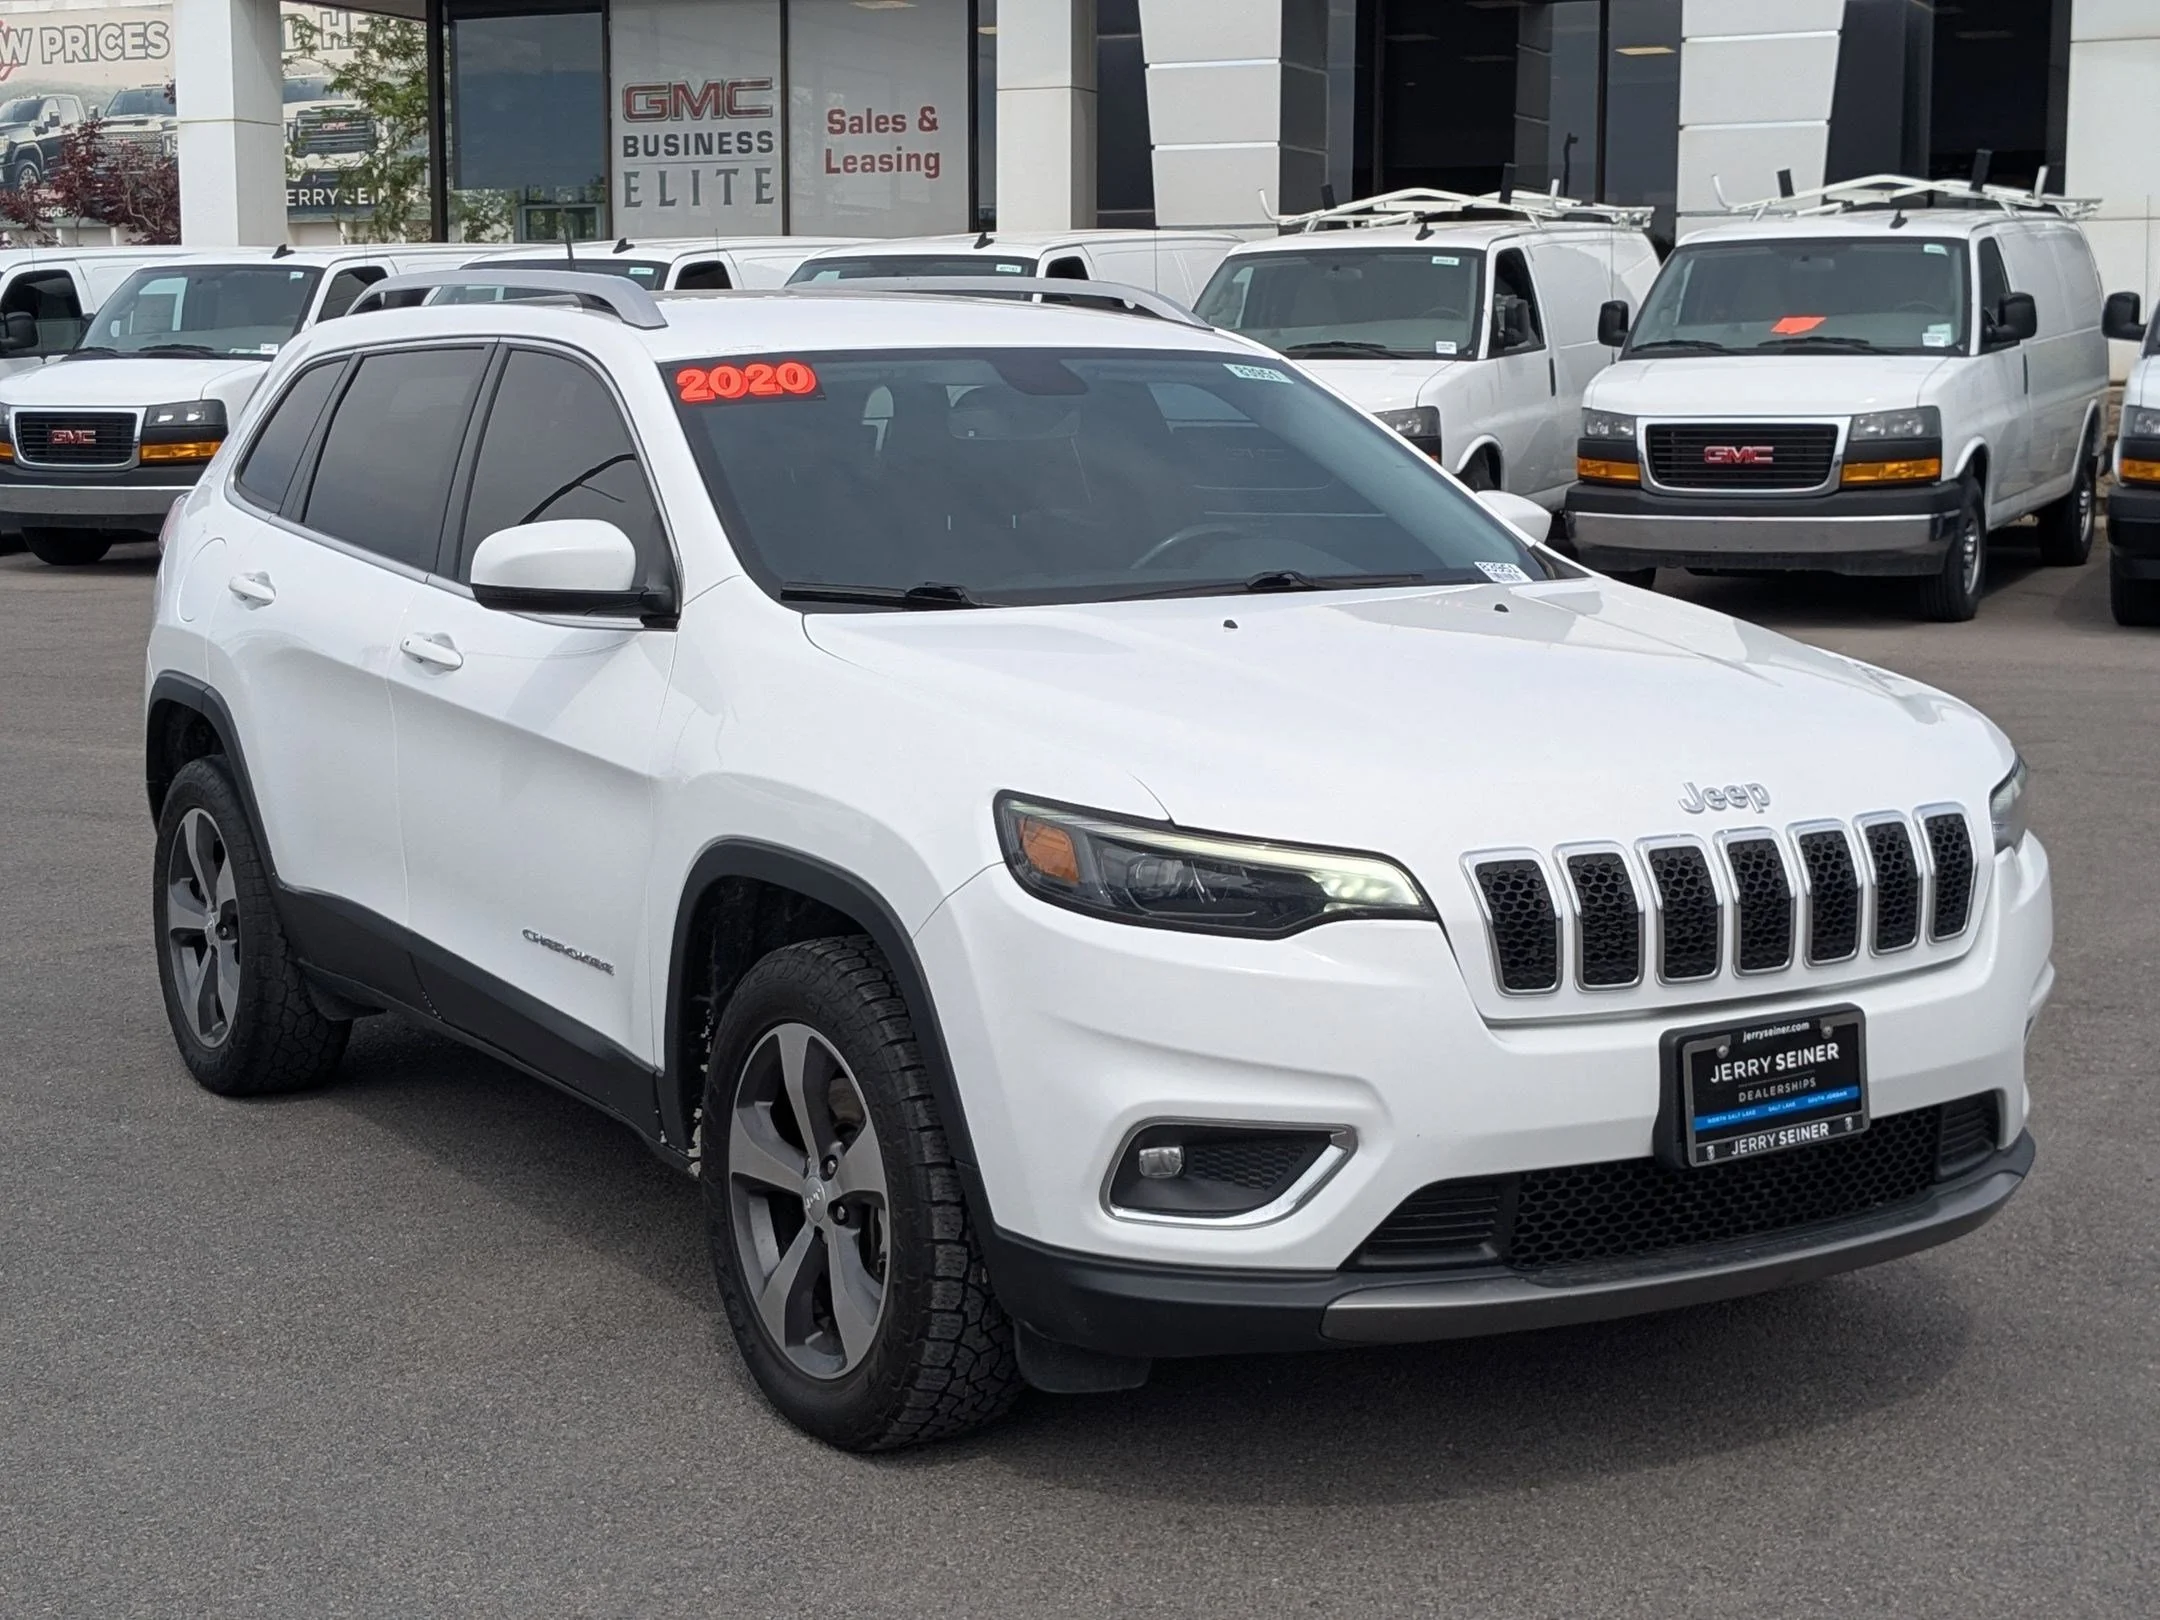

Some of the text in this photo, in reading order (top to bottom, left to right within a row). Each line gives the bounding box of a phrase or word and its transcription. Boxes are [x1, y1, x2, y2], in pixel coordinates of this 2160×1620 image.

[40, 21, 170, 65] PRICES
[622, 77, 773, 123] GMC
[827, 105, 939, 135] Sales &
[623, 130, 774, 158] BUSINESS
[824, 146, 941, 179] Leasing
[285, 188, 339, 206] ERRY
[623, 167, 775, 208] ELITE
[676, 361, 817, 402] 2020
[51, 430, 97, 444] GMC
[1704, 446, 1774, 463] GMC
[1678, 782, 1770, 814] Jeep
[522, 929, 615, 976] CHEROKEE
[1743, 1021, 1810, 1043] jerryseiner.com
[1710, 1043, 1840, 1083] JERRY SEINER
[1738, 1077, 1817, 1103] DEALERSHIPS
[1731, 1122, 1829, 1156] JERRY SEINER
